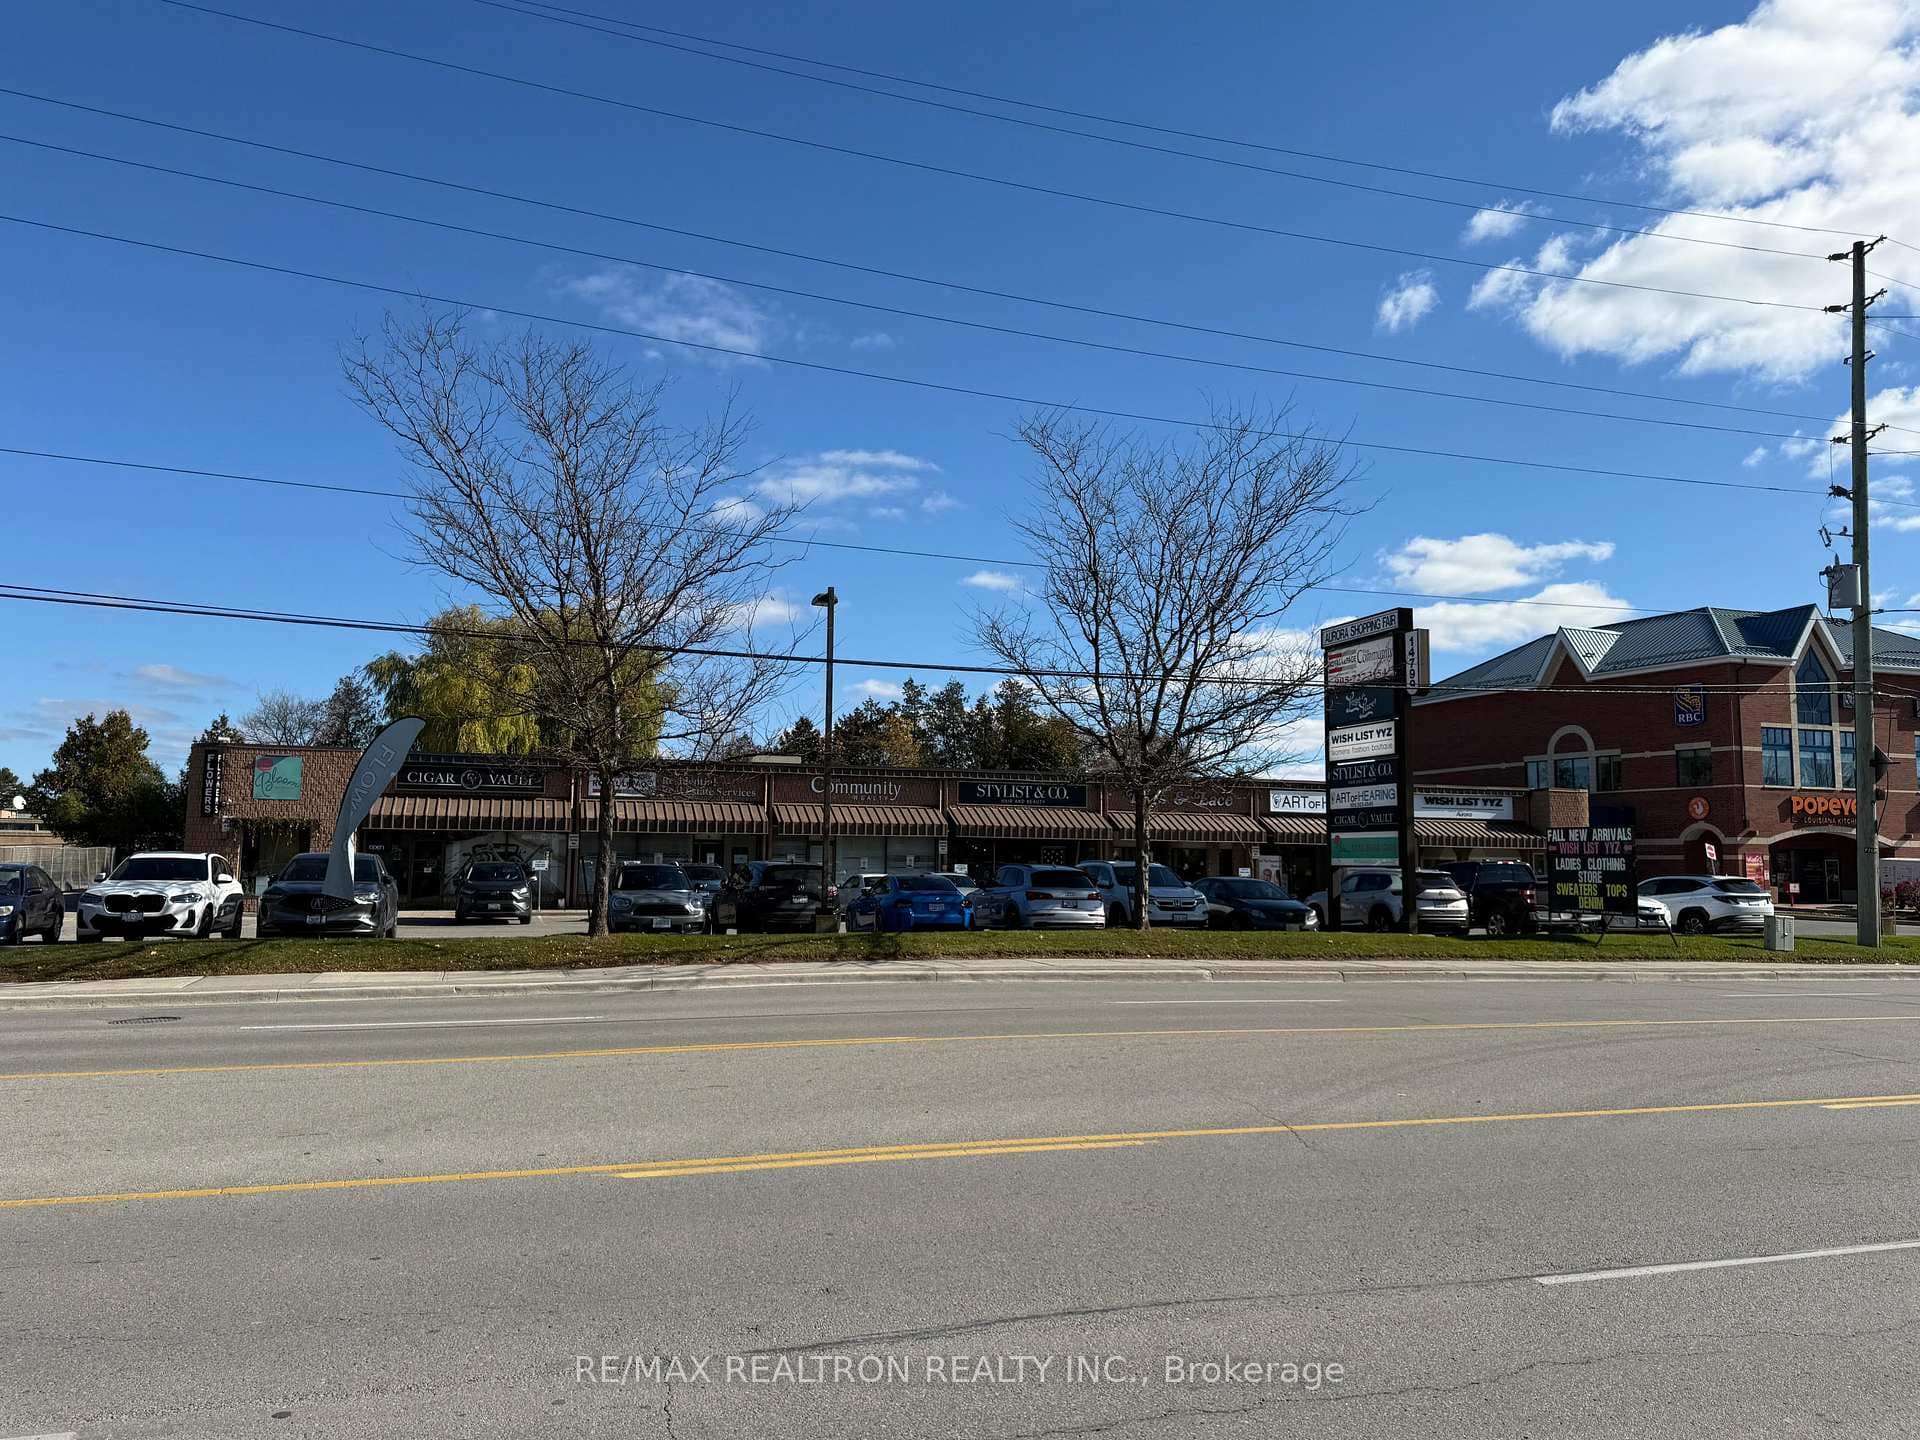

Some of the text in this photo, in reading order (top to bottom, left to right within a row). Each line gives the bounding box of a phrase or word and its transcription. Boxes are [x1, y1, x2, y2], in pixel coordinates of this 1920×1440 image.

[1351, 618, 1381, 636] SHOPPING
[1382, 614, 1396, 628] FAIR
[1678, 712, 1701, 723] RBC
[1331, 727, 1392, 744] WISH LIST YYZ
[407, 771, 456, 784] CIGAR
[1332, 765, 1367, 781] STYLIST
[204, 754, 215, 814] FLOWERS
[717, 787, 756, 797] Services
[977, 784, 1069, 800] STYLIST & CO.
[1336, 791, 1350, 803] ART
[1358, 788, 1395, 802] HEARING
[1282, 796, 1308, 809] ART
[1309, 801, 1321, 809] OF
[1424, 796, 1503, 807] WISH LIST YYZ
[1370, 812, 1393, 824] VAULT
[1547, 828, 1632, 842] FALL NEW ARRIVALS
[1559, 841, 1620, 854] WISH LIST YYZ
[1555, 857, 1626, 871] LADIES CLOTHING
[1578, 870, 1603, 883] STORE
[1556, 883, 1627, 897] SWEATERS TOPS
[1578, 896, 1604, 910] DENIM
